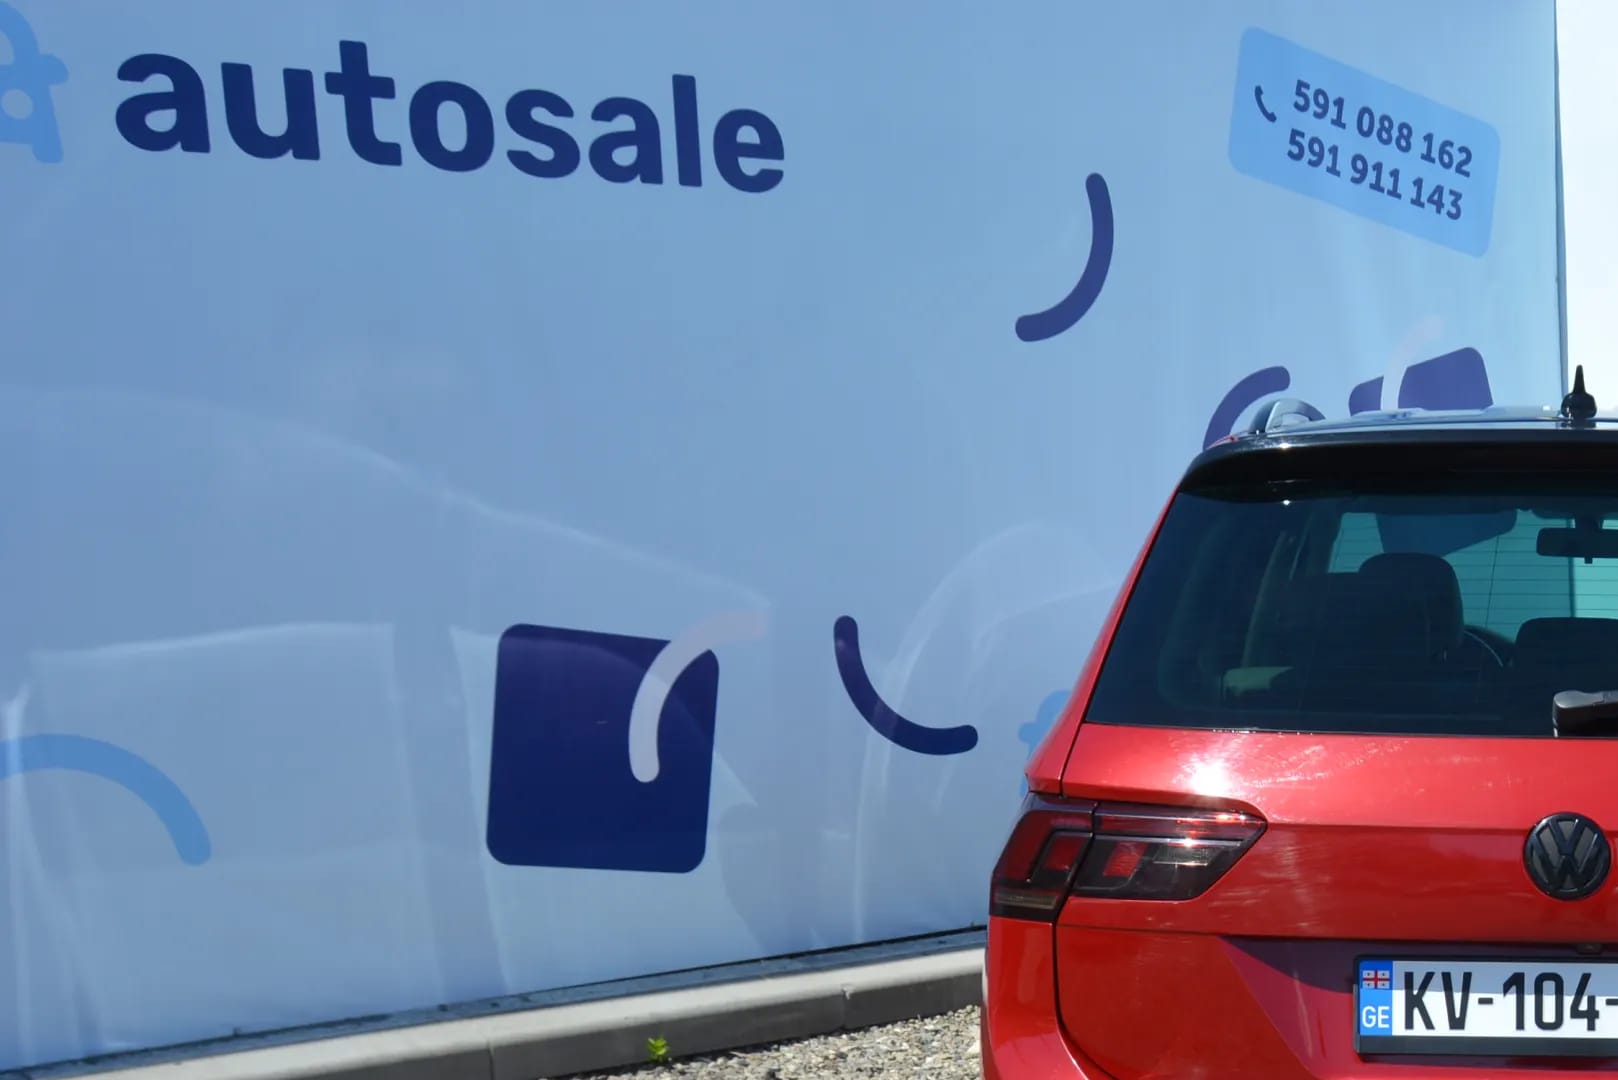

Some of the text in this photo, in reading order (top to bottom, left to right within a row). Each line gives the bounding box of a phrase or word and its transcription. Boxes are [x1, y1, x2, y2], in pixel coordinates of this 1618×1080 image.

[115, 40, 785, 194] autosale
[1293, 79, 1472, 178] 591 088 162
[1287, 128, 1463, 220] 591 911 143
[1362, 1006, 1390, 1029] GE
